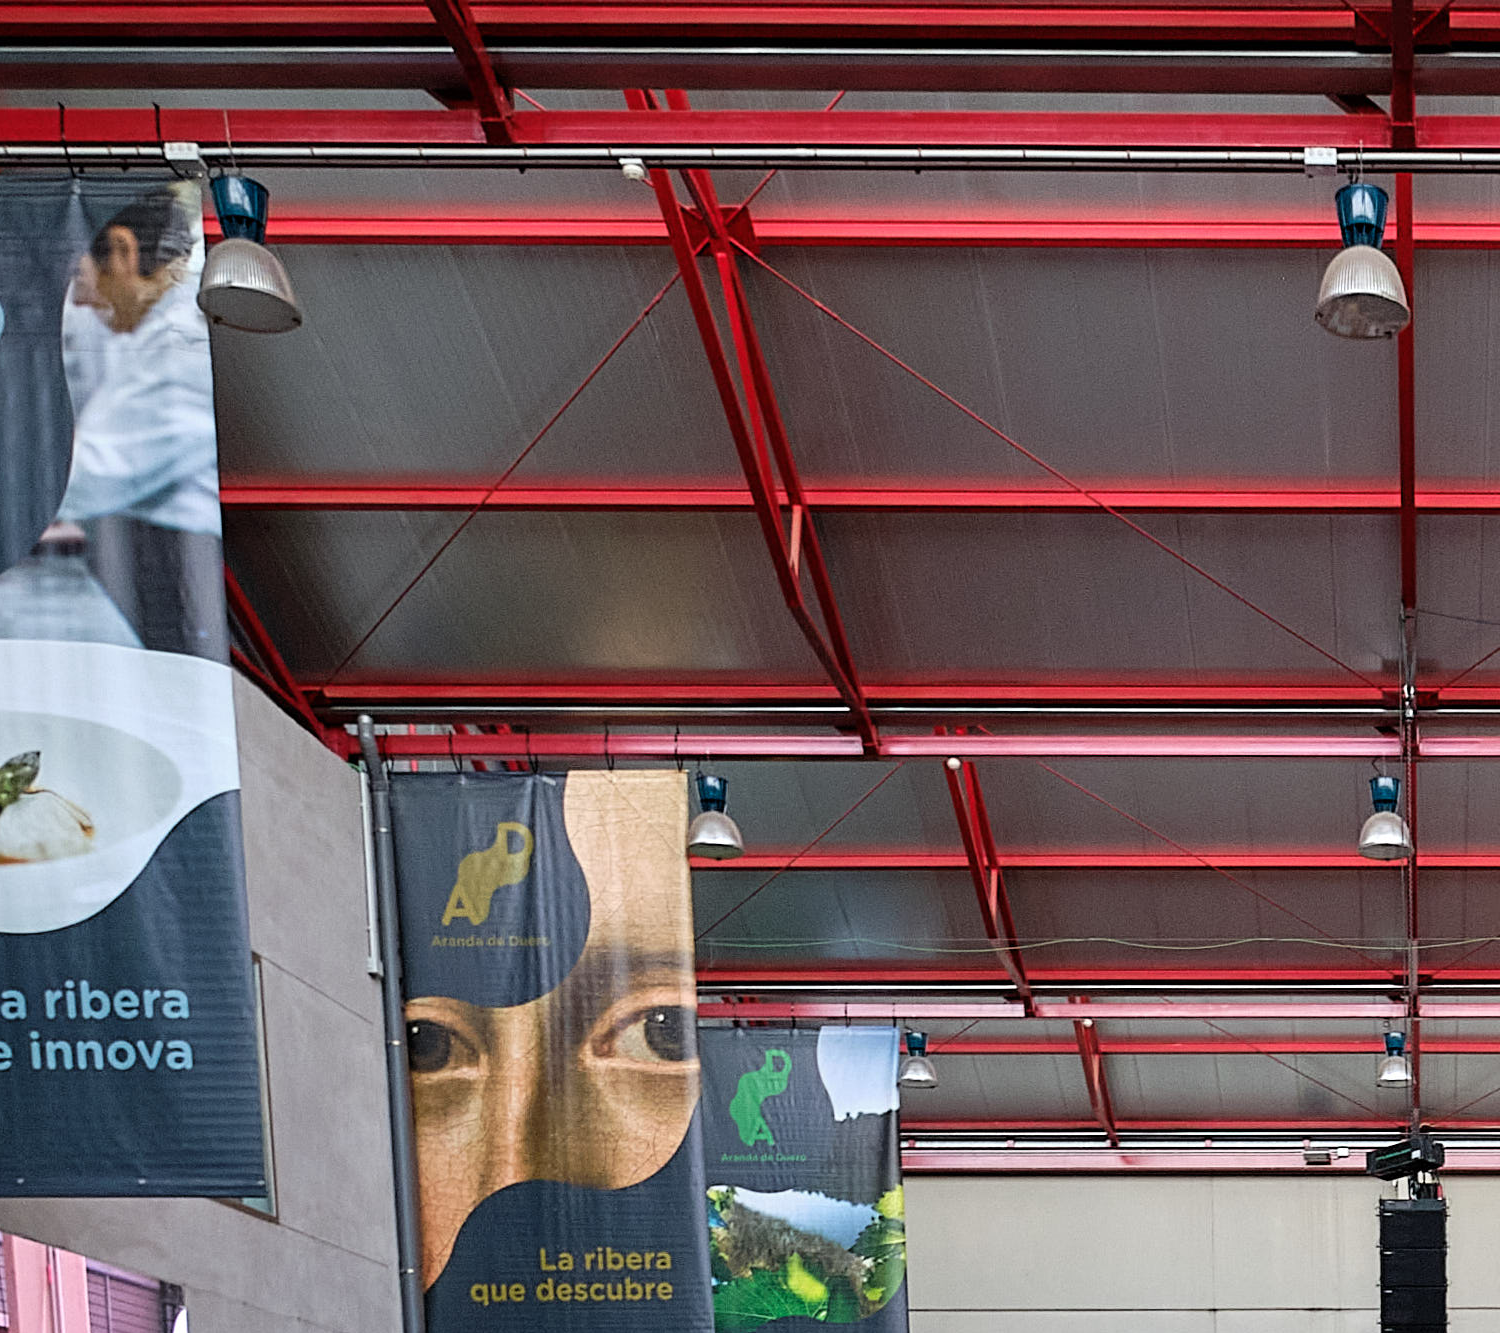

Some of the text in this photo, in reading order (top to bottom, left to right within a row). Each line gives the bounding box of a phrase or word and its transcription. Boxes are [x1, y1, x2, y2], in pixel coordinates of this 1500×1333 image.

[431, 935, 484, 947] Aranda
[44, 979, 191, 1020] ribera
[29, 1030, 194, 1070] innova
[539, 1247, 673, 1271] La ribera
[470, 1277, 674, 1306] que descubre
